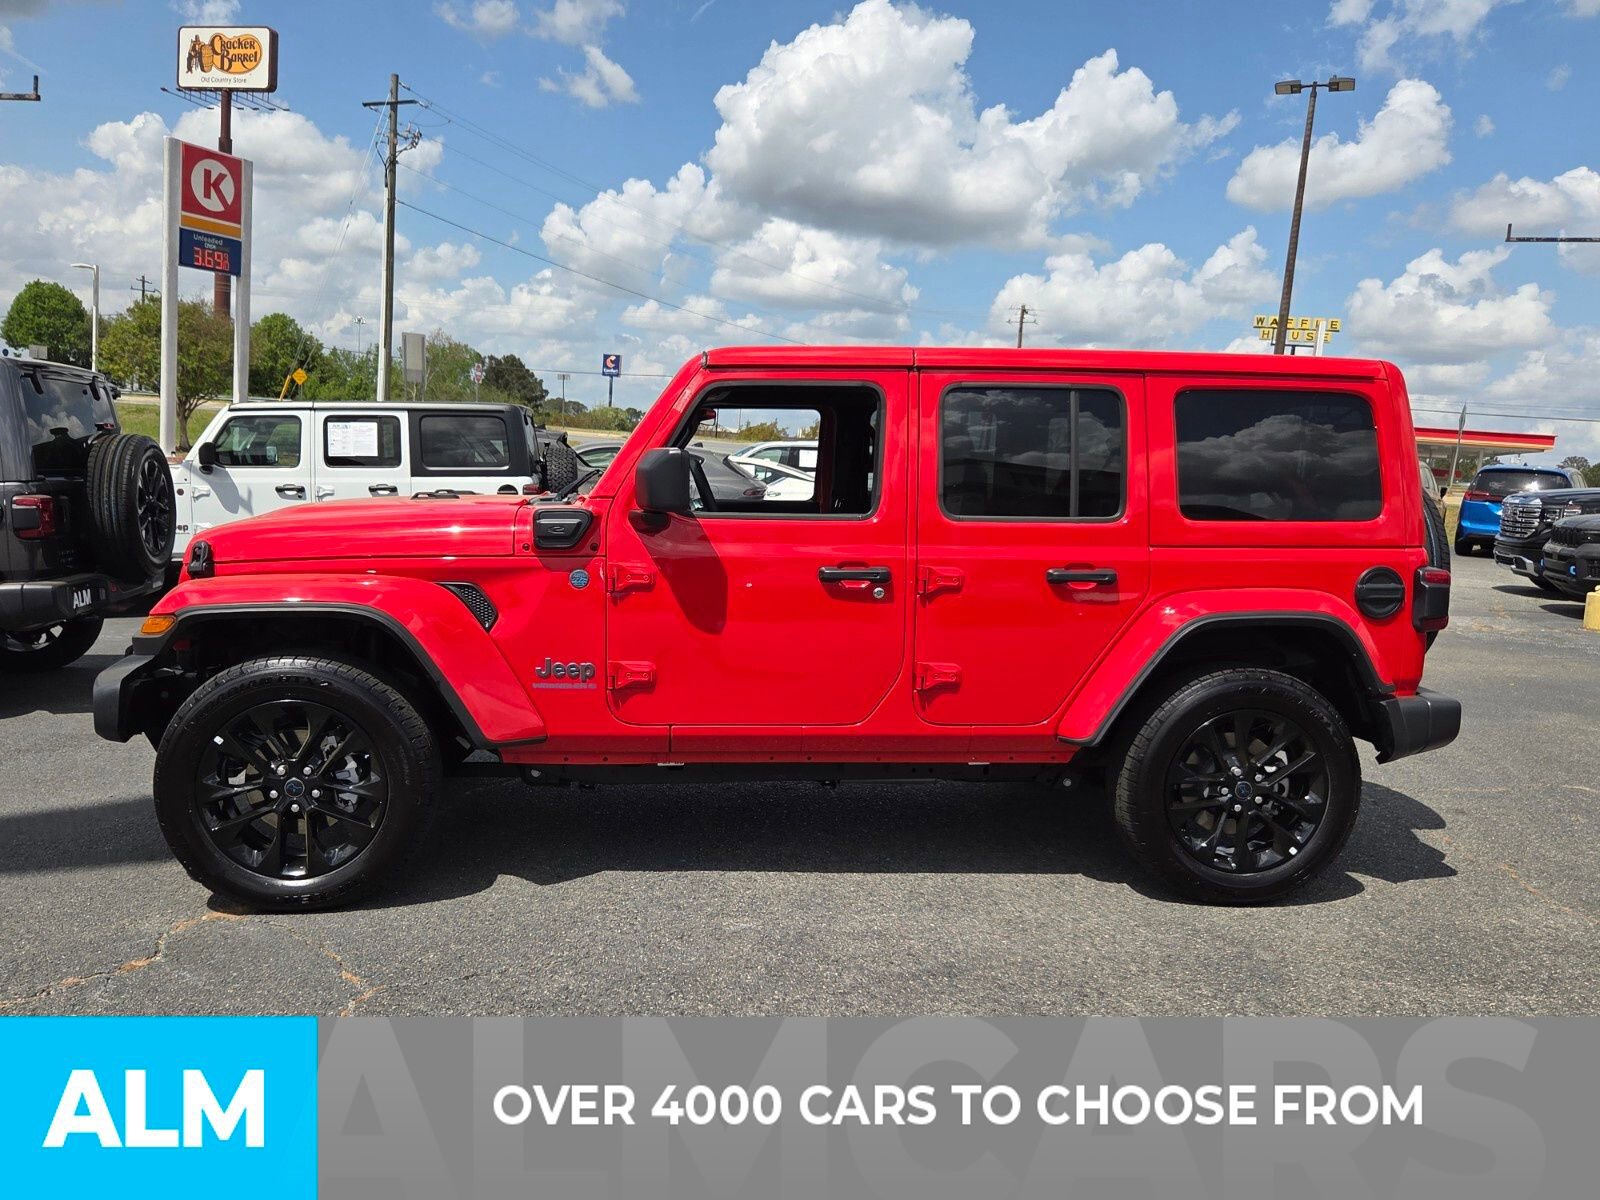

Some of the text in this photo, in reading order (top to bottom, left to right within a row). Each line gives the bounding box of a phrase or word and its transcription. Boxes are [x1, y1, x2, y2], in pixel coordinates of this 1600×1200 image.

[210, 34, 256, 56] Cracker
[220, 49, 258, 73] Barrel
[211, 76, 232, 85] Country
[233, 76, 247, 84] Store
[203, 168, 231, 209] K
[1261, 330, 1329, 342] HUSE
[73, 588, 92, 609] ALM
[535, 657, 596, 682] Jeep
